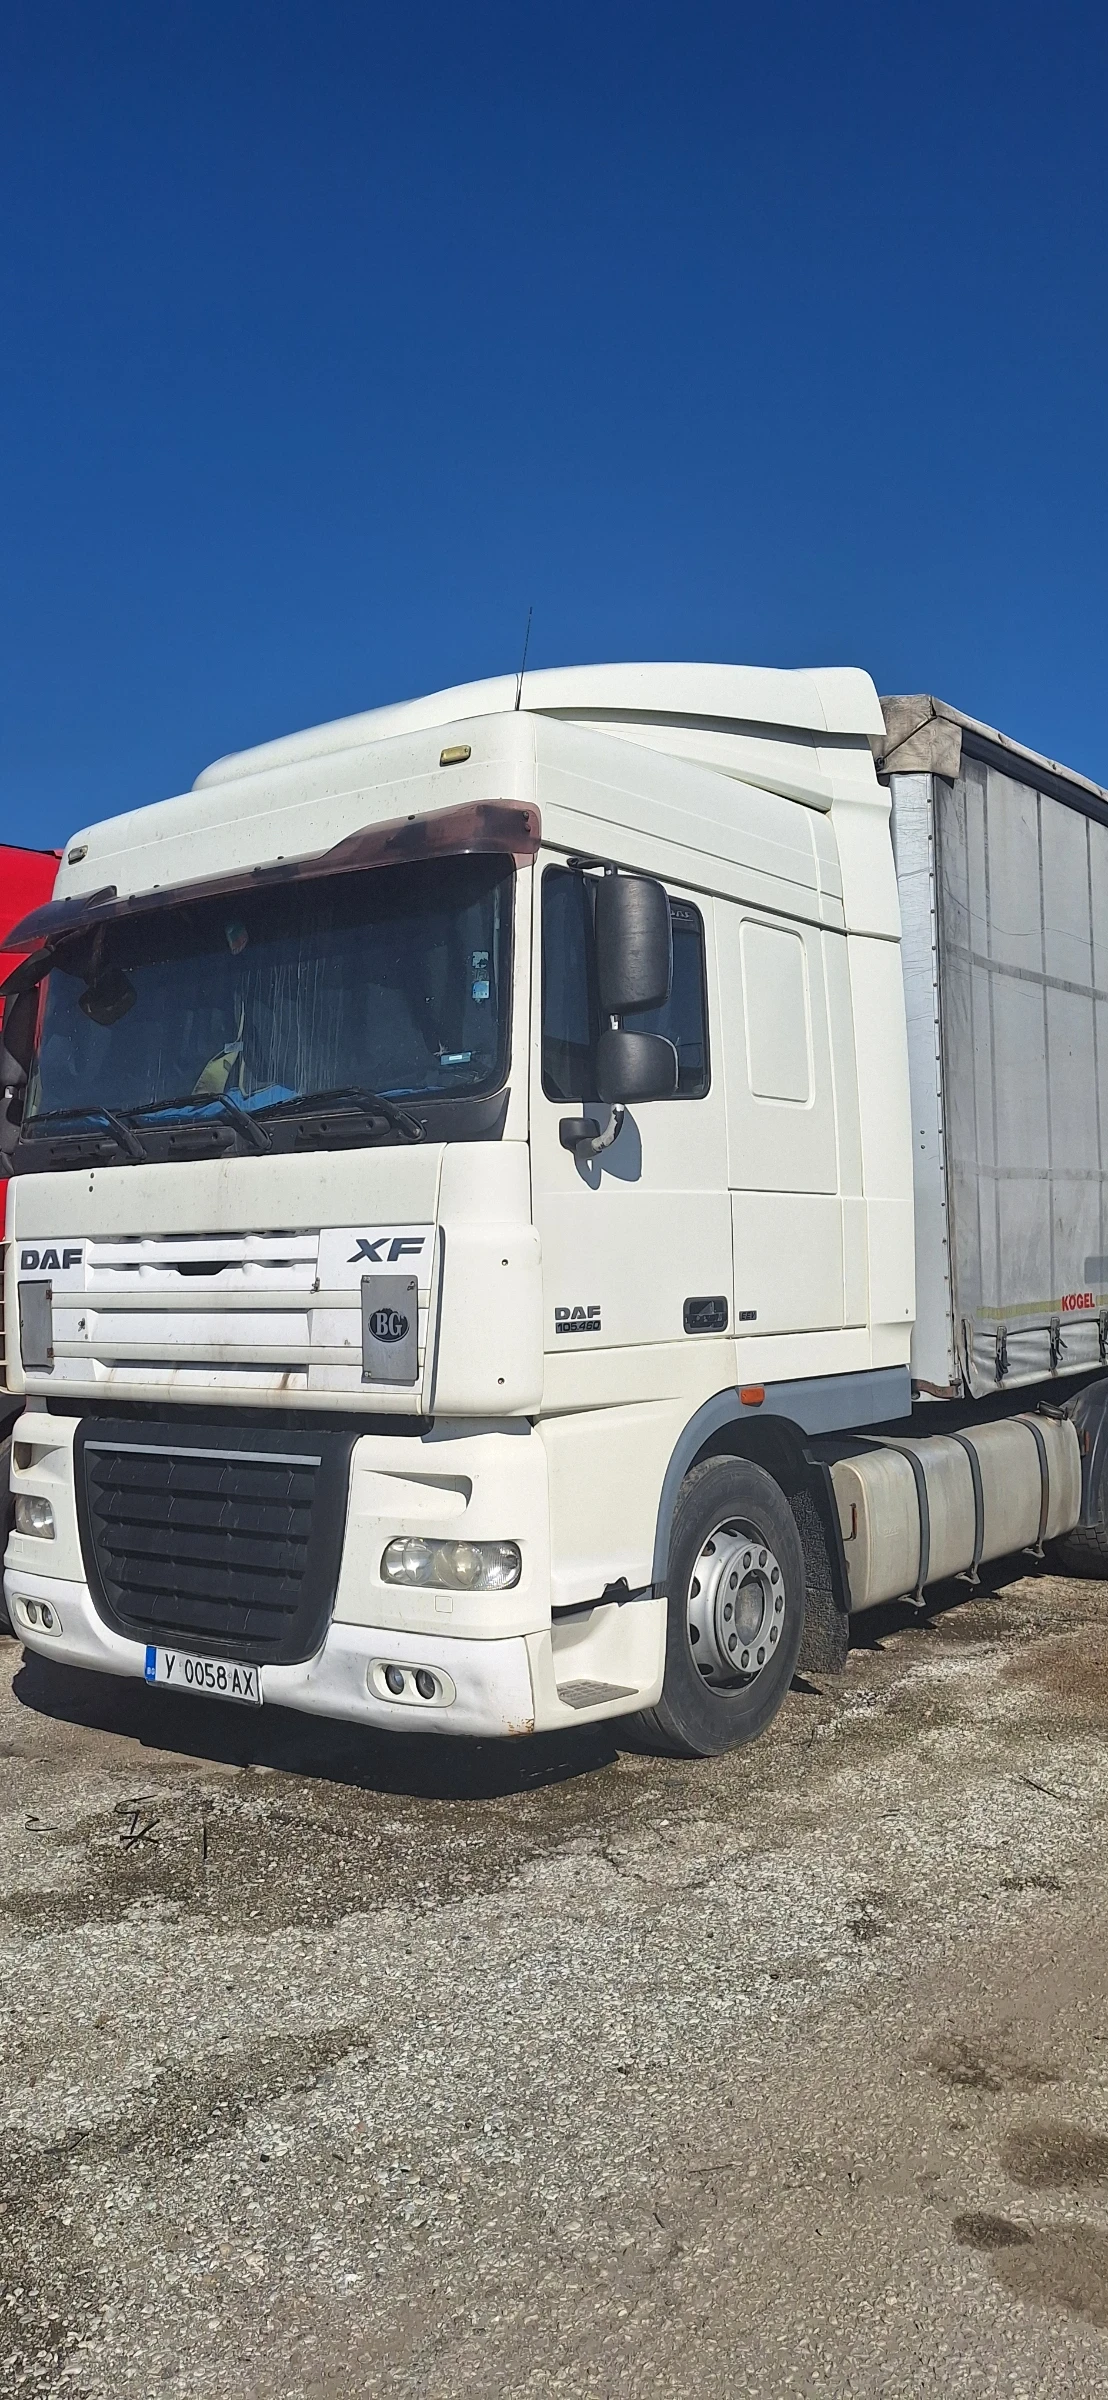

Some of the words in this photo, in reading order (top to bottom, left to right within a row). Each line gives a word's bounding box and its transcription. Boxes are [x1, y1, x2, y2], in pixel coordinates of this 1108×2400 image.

[20, 1248, 84, 1270] DAF
[346, 1237, 426, 1263] XF
[555, 1305, 601, 1320] DAF
[1061, 1293, 1095, 1311] KÖGEL
[376, 1312, 402, 1336] BG
[556, 1320, 601, 1332] 105.460
[165, 1653, 176, 1679] Y
[185, 1659, 227, 1690] 0058
[232, 1668, 255, 1697] AX
